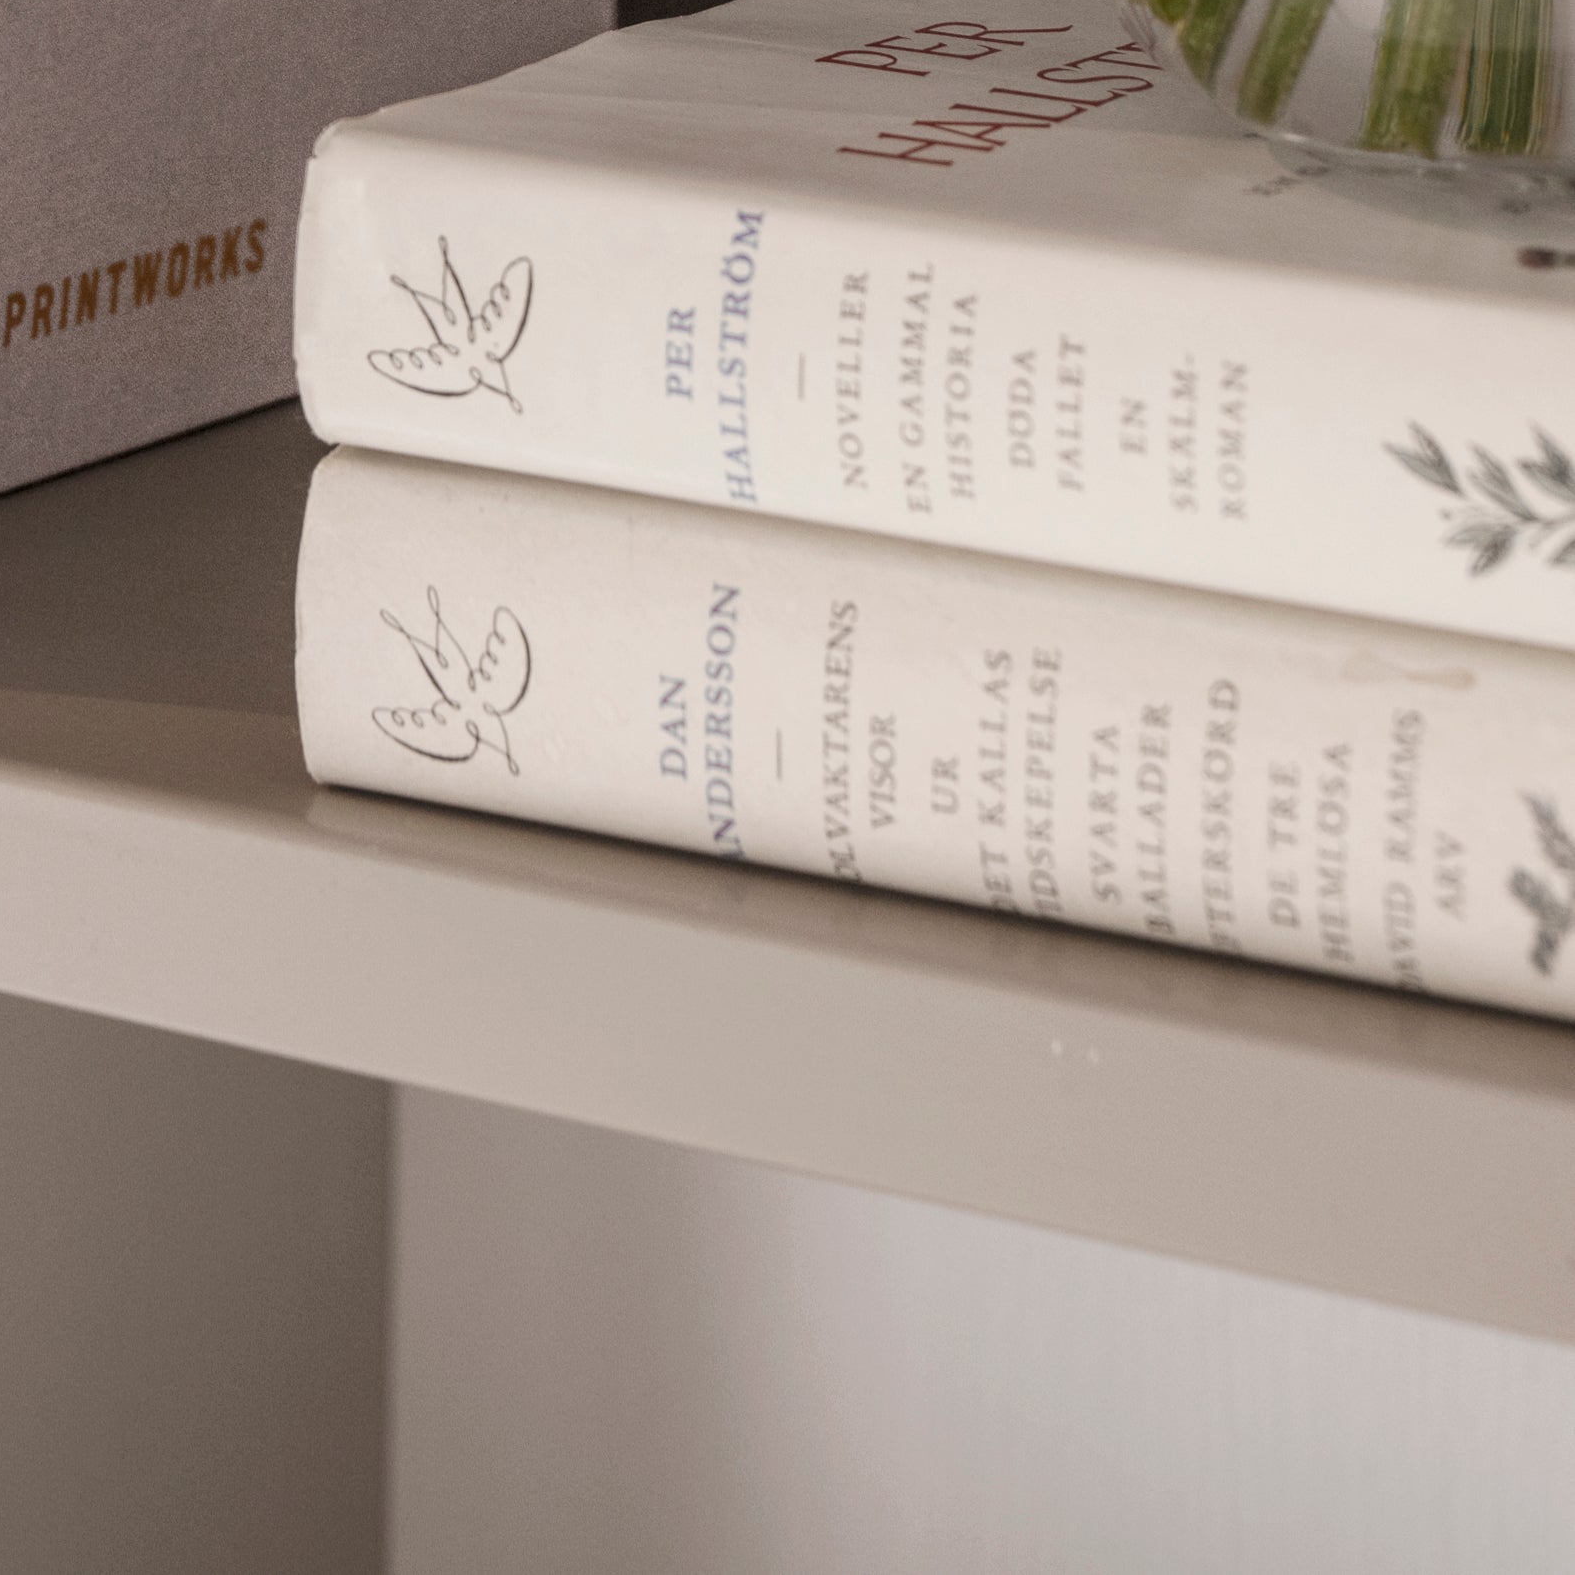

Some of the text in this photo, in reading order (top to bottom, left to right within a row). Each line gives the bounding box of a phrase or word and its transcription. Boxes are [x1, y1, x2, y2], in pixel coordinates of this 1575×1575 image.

[814, 20, 1073, 78] PER
[836, 41, 1164, 168] HALLST
[1, 217, 268, 349] PRINTWORKS
[664, 306, 697, 402] PER
[715, 209, 767, 505] HALLSTRÖM
[834, 269, 871, 493] NOVELLER
[898, 260, 936, 518] EN GAMMAL
[944, 291, 979, 503] HISTORIA
[1054, 331, 1087, 494] FALLET
[1118, 396, 1149, 457] EN
[1216, 358, 1249, 522] ROMAN
[657, 672, 689, 781] DAN
[868, 711, 899, 831] VISOR
[930, 754, 961, 817] UR
[977, 647, 1013, 830] KALLAS
[1023, 645, 1064, 917] IDSKEPELSE
[1088, 724, 1122, 906] SVARTA
[1265, 758, 1302, 931] DE TRE
